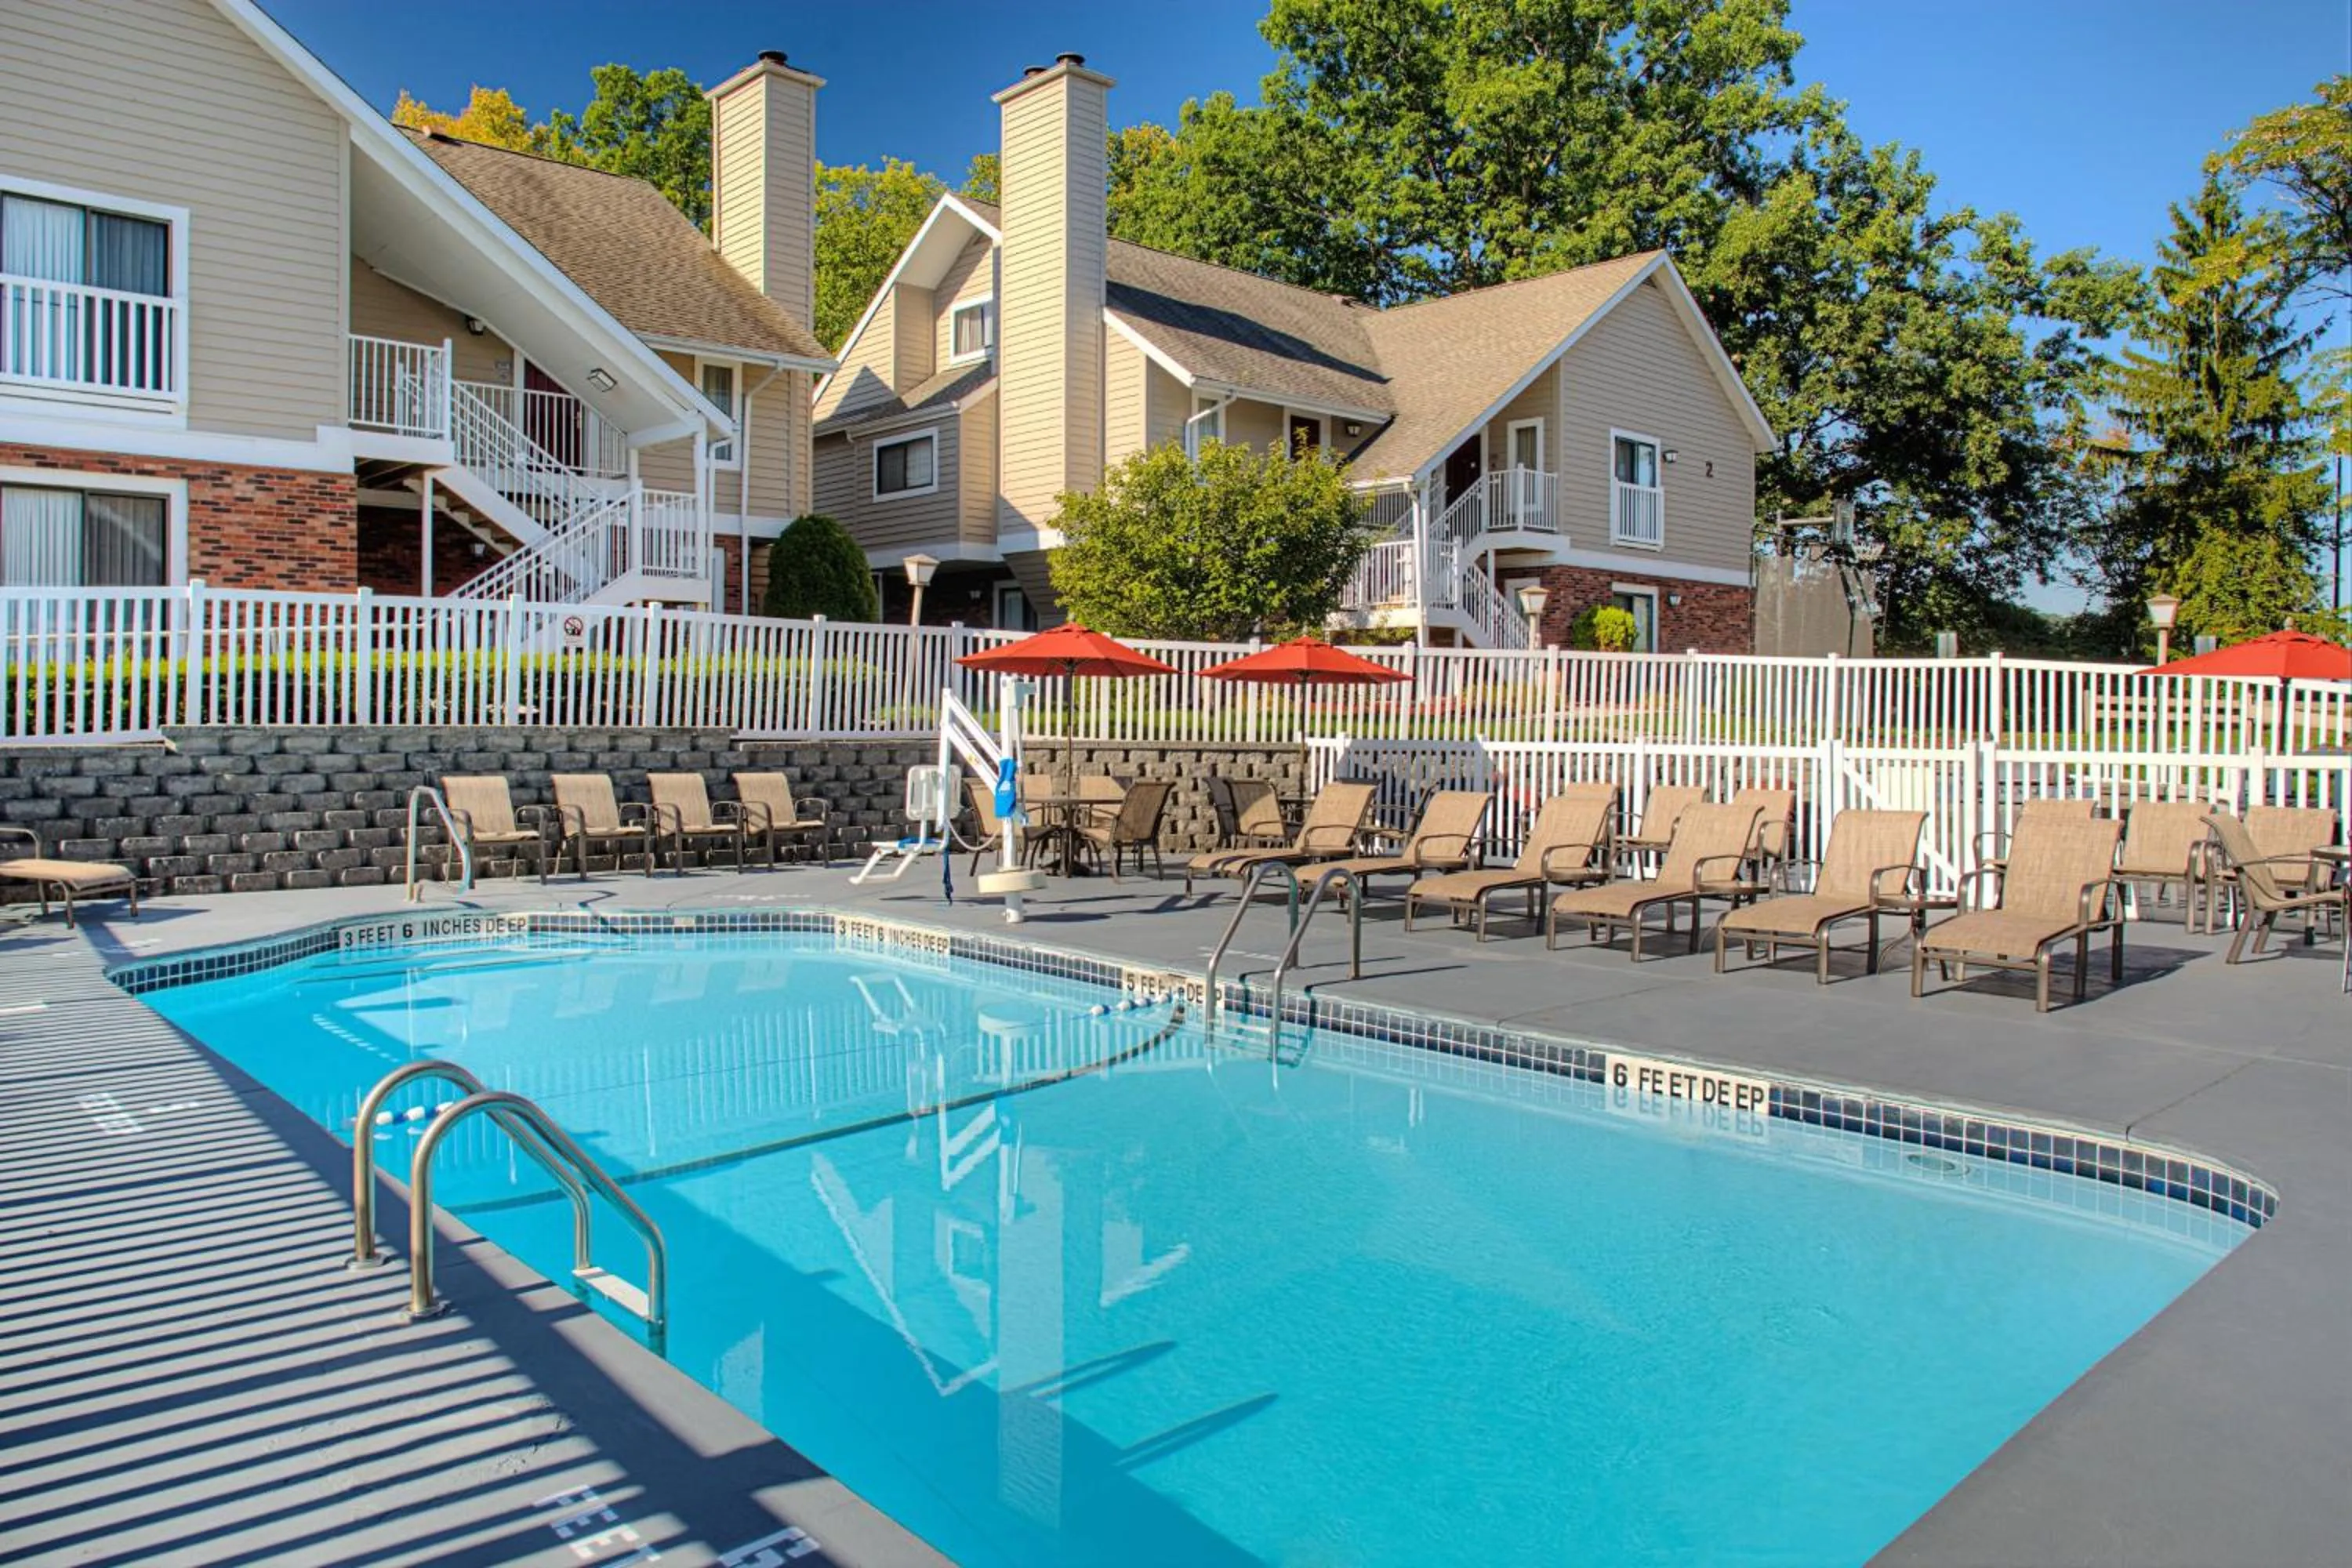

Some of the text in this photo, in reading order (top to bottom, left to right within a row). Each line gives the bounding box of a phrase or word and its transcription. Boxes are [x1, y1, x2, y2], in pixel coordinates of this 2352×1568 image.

[1705, 461, 1714, 478] 2
[344, 917, 526, 947] 3 FEET 6 INCHES DEEP
[839, 920, 847, 935] 3
[851, 921, 875, 938] FEET
[877, 926, 884, 942] 6
[924, 934, 949, 953] DEEP
[1127, 973, 1222, 1004] 5 FE DEP
[1613, 1062, 1764, 1111] 6 FEET DEEP
